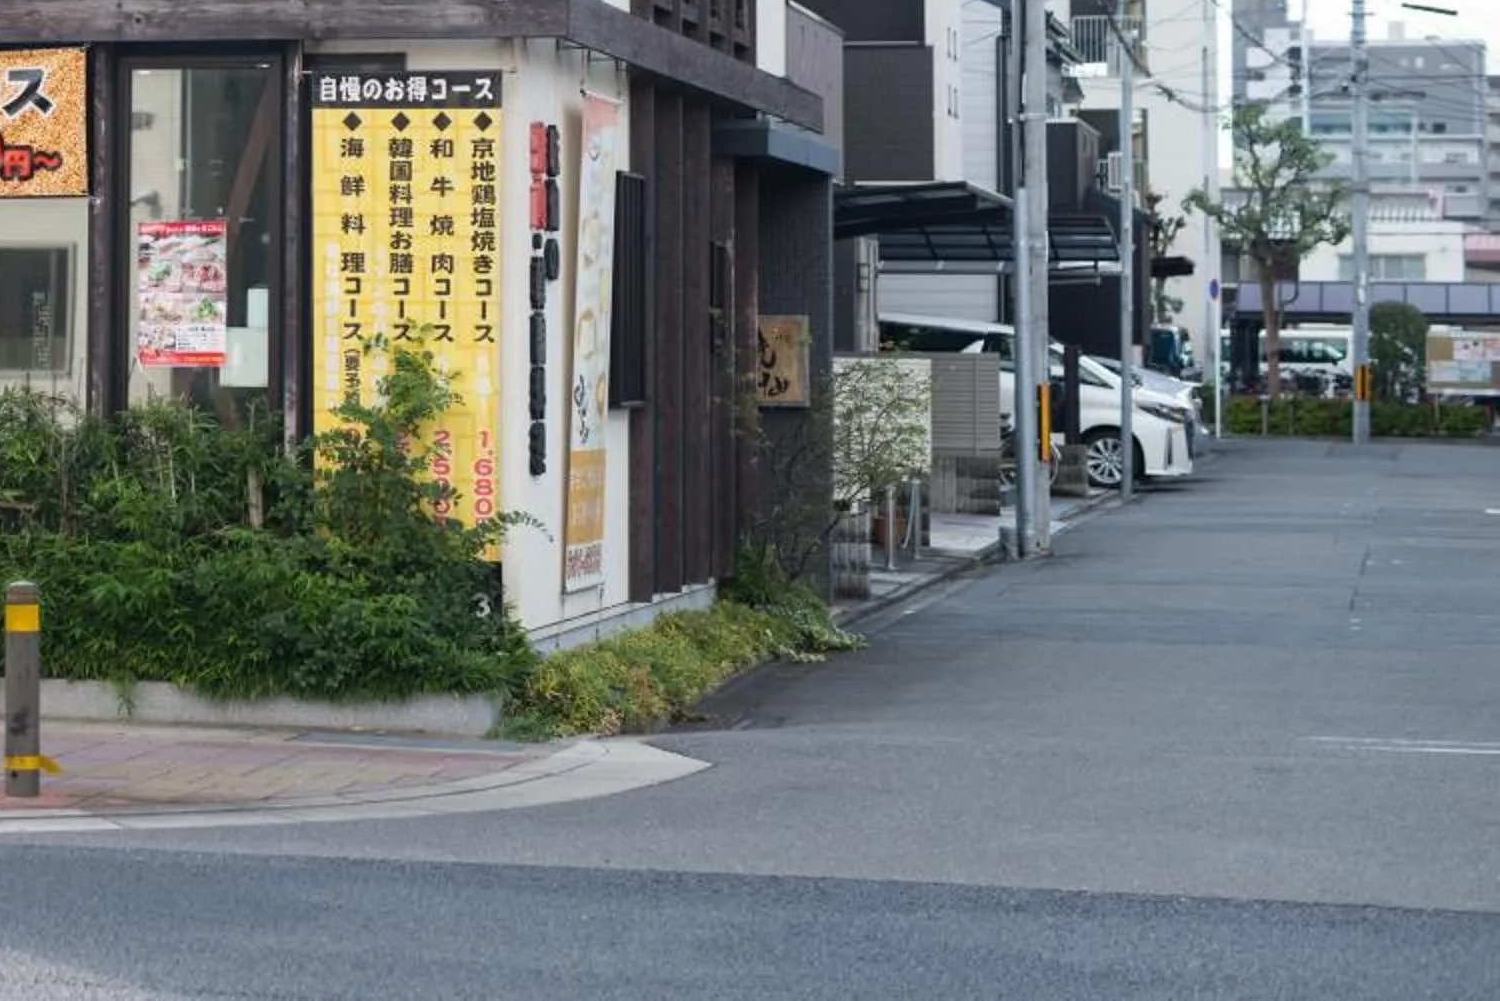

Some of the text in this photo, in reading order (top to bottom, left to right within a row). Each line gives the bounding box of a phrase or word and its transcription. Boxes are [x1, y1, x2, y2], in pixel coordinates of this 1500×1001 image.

[319, 75, 494, 102] 自慢のお得コース
[340, 137, 365, 341] 海鮮料理コース
[388, 137, 414, 342] 韓国料理お膳コース
[429, 138, 454, 343] 和牛焼肉コース
[471, 138, 496, 343] 京地鶏塩焼きコース
